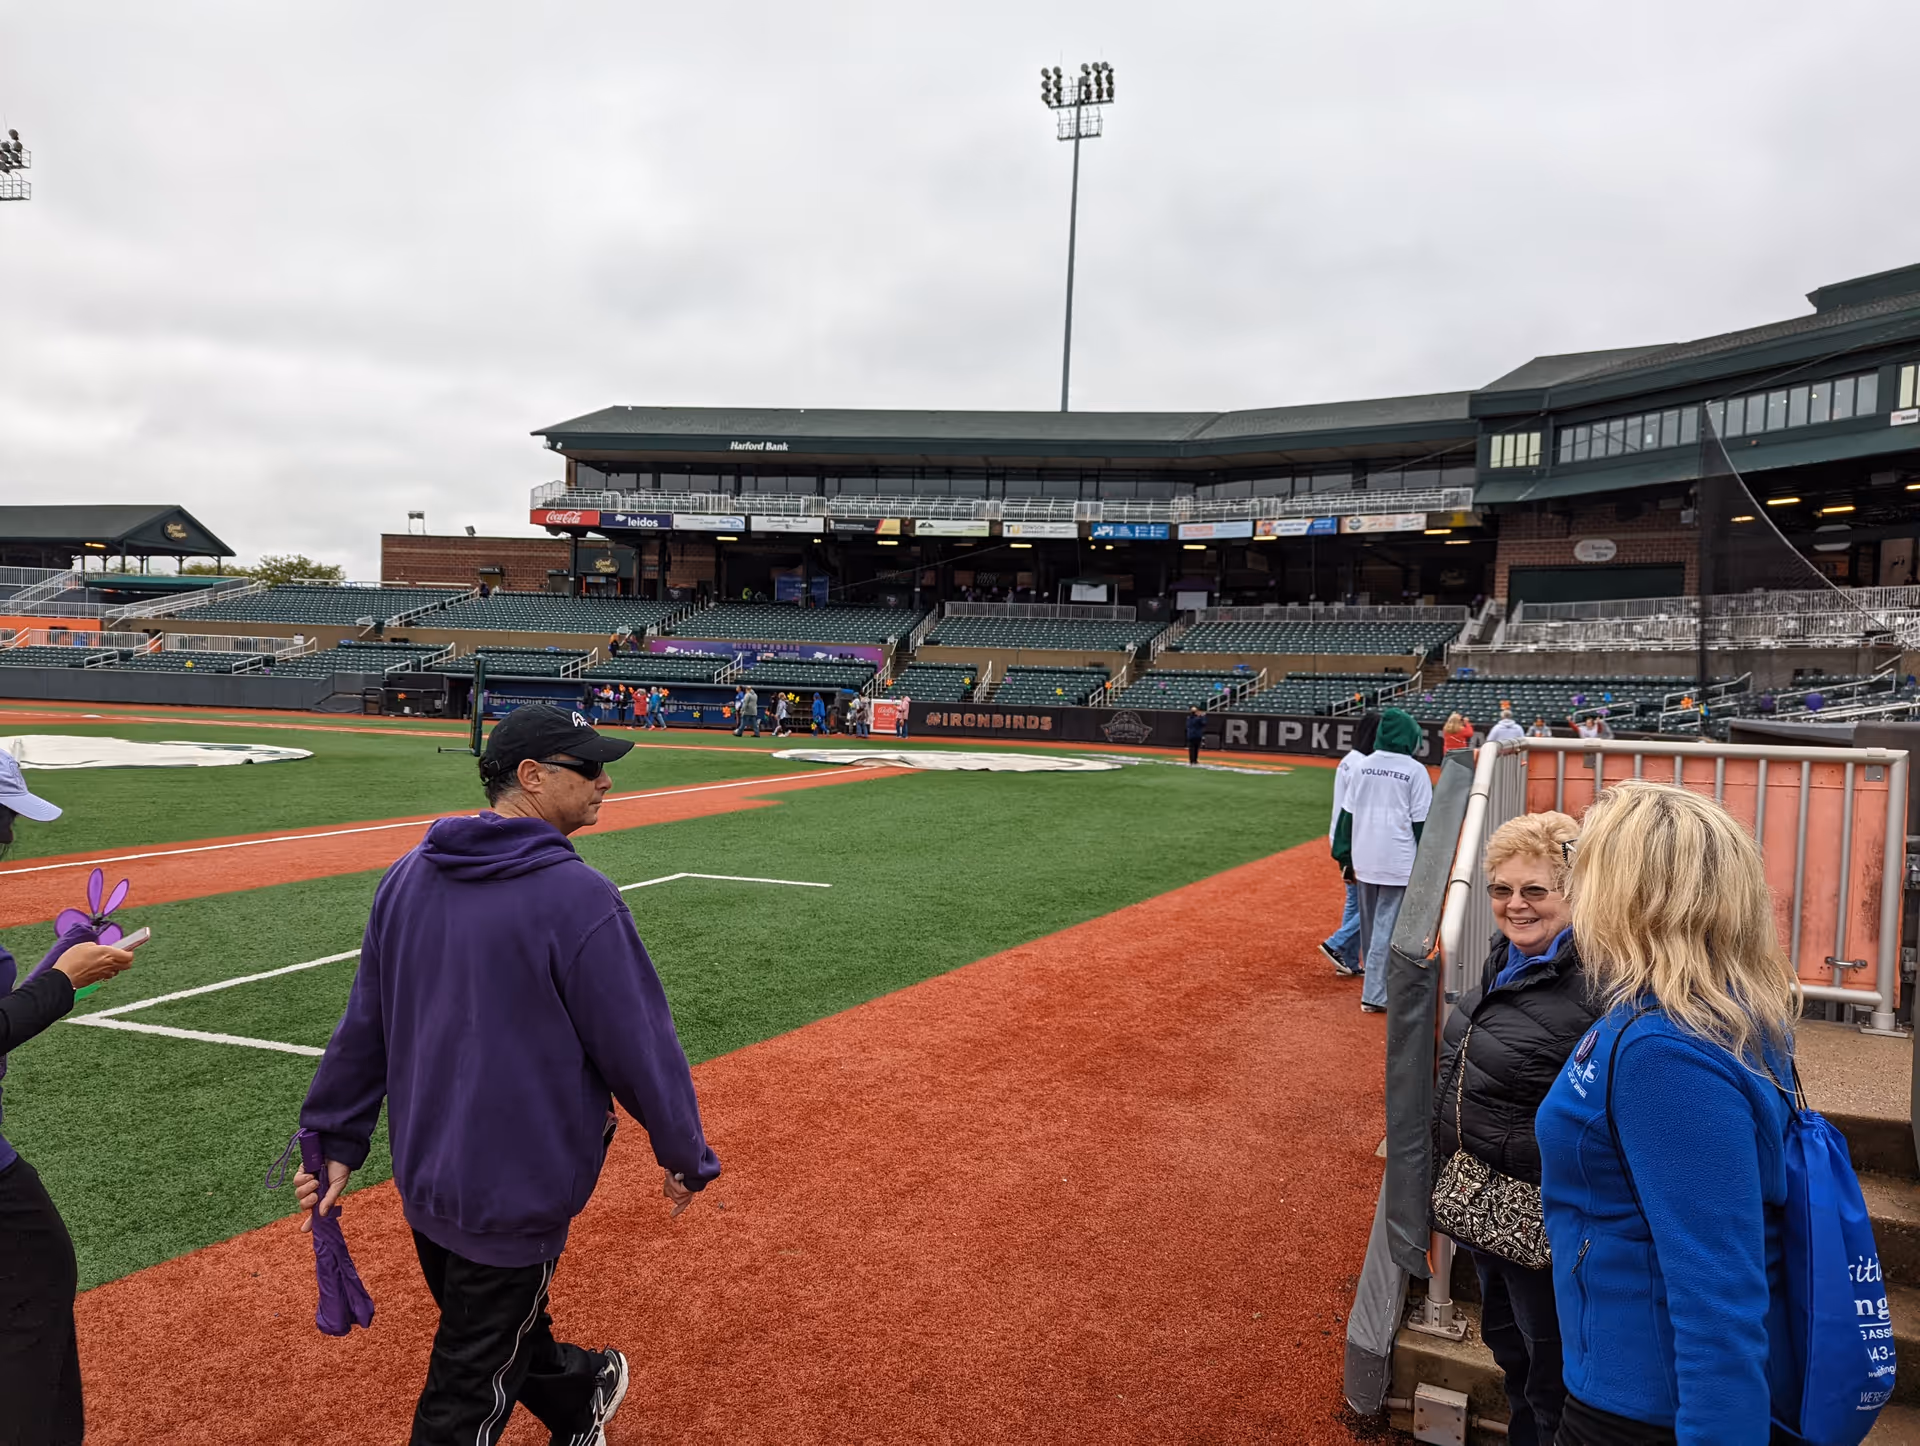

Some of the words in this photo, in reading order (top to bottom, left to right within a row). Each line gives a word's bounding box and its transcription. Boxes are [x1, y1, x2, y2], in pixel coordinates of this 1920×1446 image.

[730, 441, 764, 451] Harford
[765, 441, 789, 451] Bank
[627, 516, 659, 527] leidos
[926, 712, 1053, 730] #IRONBIRDS
[1225, 719, 1354, 751] RIPKE
[1361, 768, 1411, 782] VOLUNTEER
